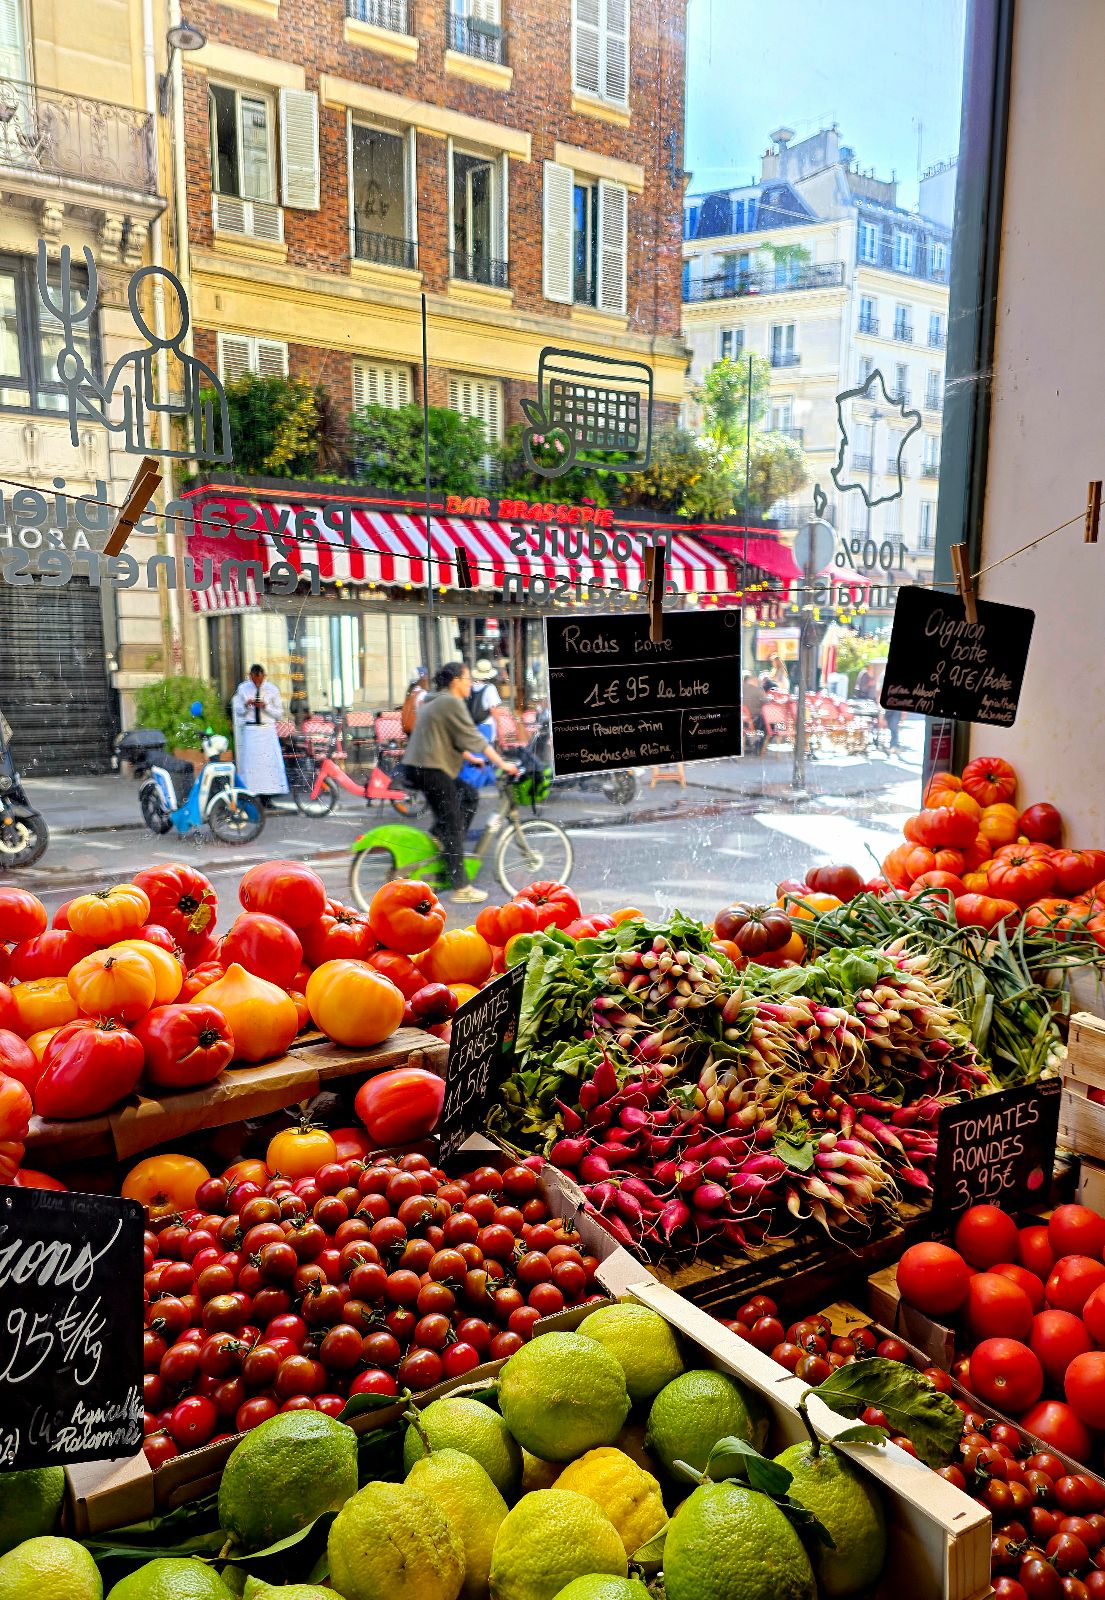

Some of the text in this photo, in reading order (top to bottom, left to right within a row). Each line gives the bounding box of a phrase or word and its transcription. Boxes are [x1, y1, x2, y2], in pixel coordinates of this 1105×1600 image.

[446, 495, 614, 527] BAR BRASSERIE
[562, 624, 620, 653] Radis
[951, 639, 988, 663] botte
[657, 680, 676, 698] la
[679, 680, 710, 696] botte
[455, 987, 509, 1045] TOMATES
[949, 1099, 1039, 1146] TOMATES
[952, 1134, 1024, 1172] RONDES
[950, 1160, 1015, 1211] 3,95€
